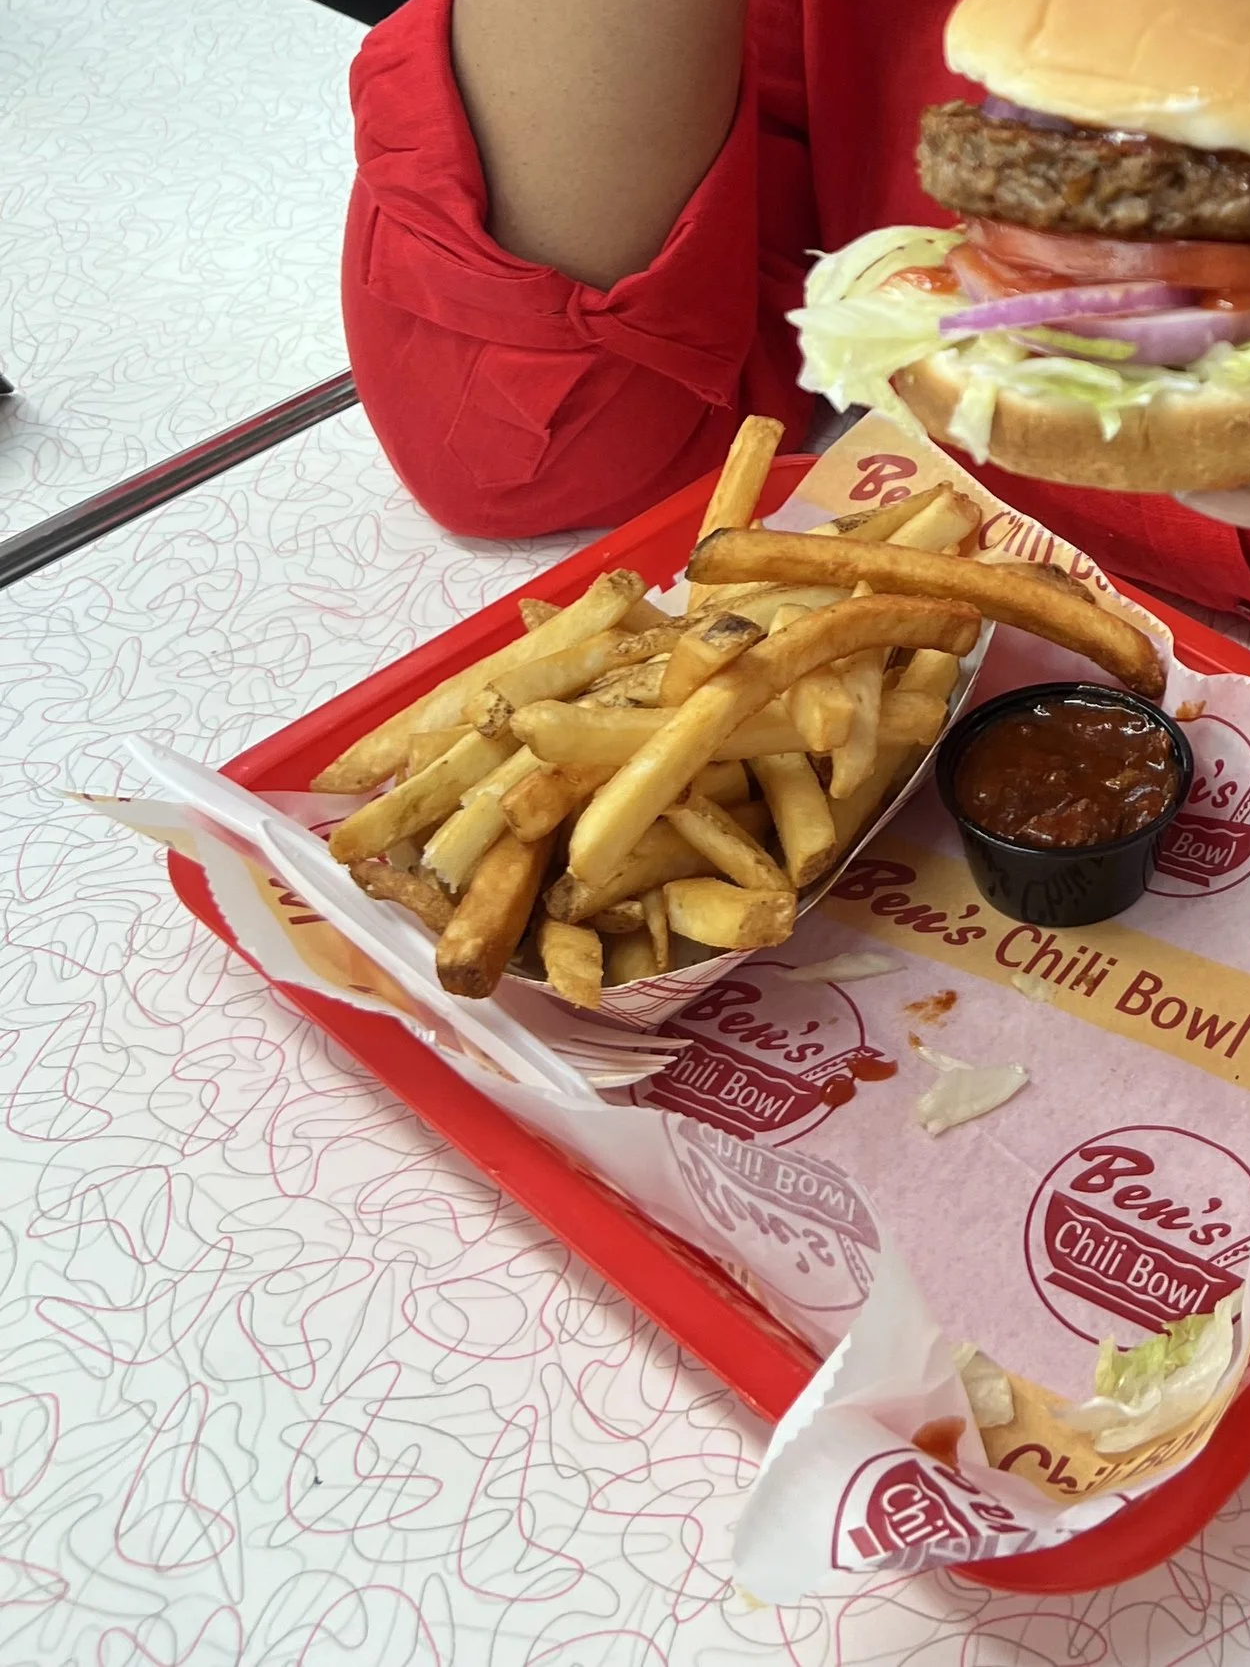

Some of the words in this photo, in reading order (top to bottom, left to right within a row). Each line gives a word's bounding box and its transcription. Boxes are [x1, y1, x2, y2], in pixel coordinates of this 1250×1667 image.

[1171, 832, 1237, 867] Bowl
[829, 859, 987, 945] Ben's
[994, 923, 1119, 998] Chili
[680, 980, 825, 1063] Ben's
[719, 1070, 796, 1122] Bowl
[1071, 1144, 1233, 1247] Ben's
[1054, 1219, 1127, 1274] Chili
[1126, 1256, 1210, 1315] Bowl
[881, 1483, 950, 1544] Chil
